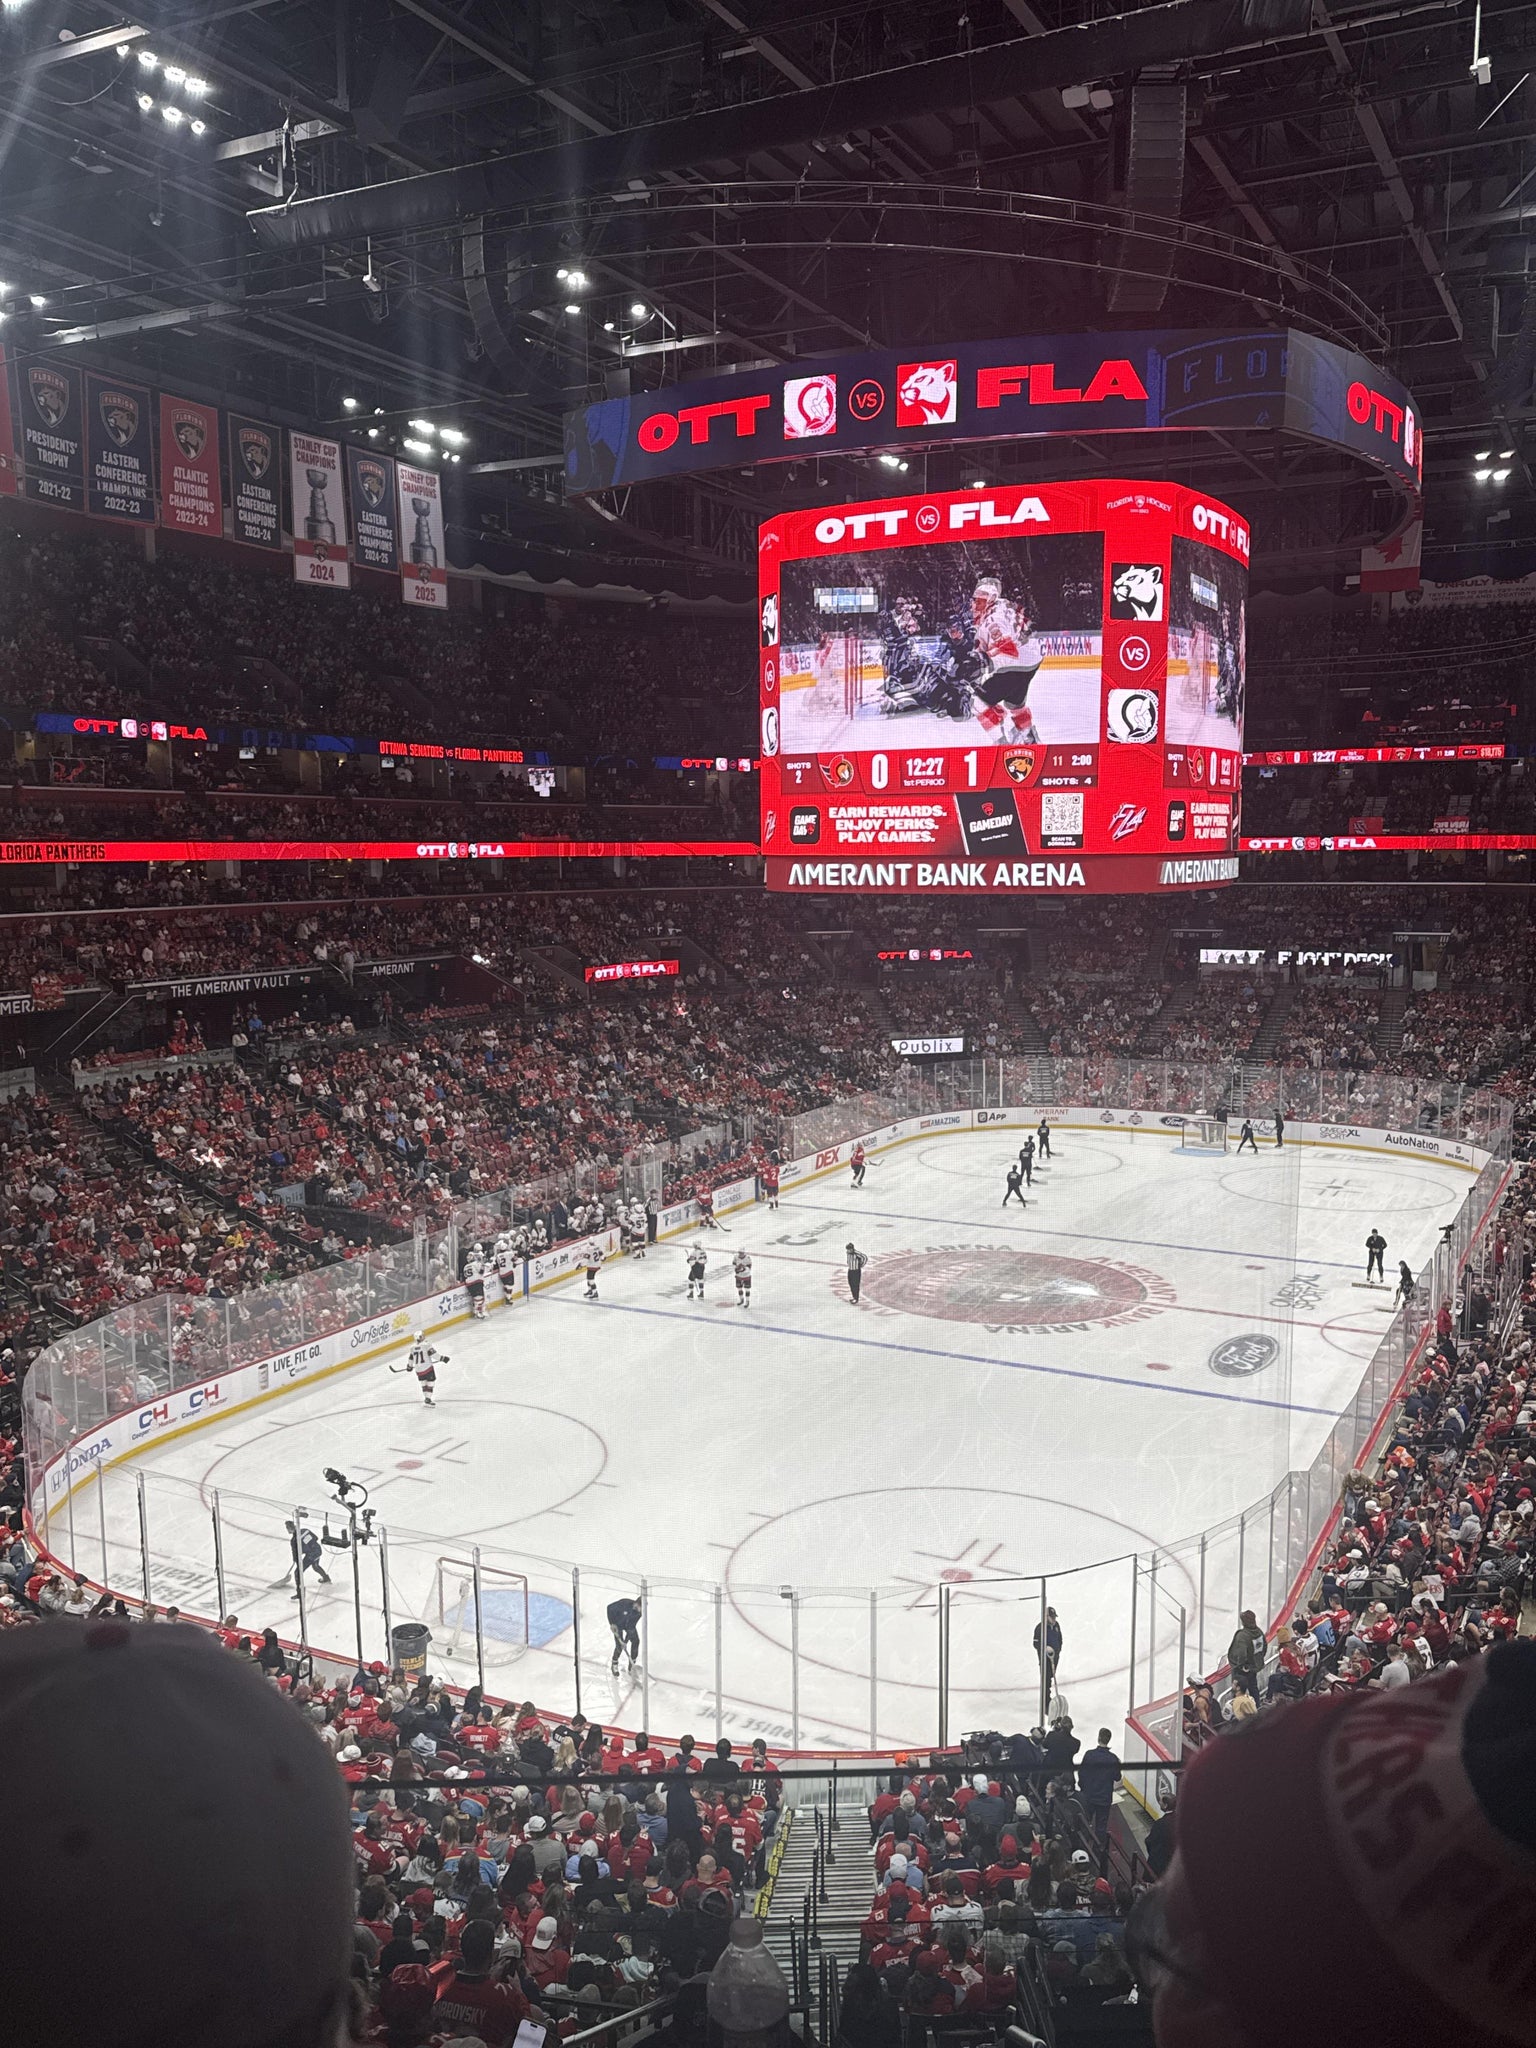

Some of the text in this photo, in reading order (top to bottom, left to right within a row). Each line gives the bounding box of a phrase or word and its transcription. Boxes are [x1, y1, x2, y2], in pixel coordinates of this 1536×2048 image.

[637, 359, 1149, 453] OTT VS FLA
[1347, 381, 1403, 443] OTT
[26, 428, 78, 454] PRESIDENTS'
[293, 436, 337, 458] STANLEY CUP
[37, 447, 69, 469] TROPHY
[102, 450, 140, 470] EASTERN
[296, 450, 336, 470] CHAMPIONS
[95, 463, 147, 486] CONFERENCE
[173, 466, 209, 485] ATLANTIC
[400, 468, 437, 487] STANLEY CUP
[38, 479, 72, 500] 2021-22
[174, 480, 209, 499] DIVISION
[242, 483, 271, 500] EASTERN
[402, 481, 437, 500] CHAMPIONS
[104, 496, 141, 514] 2022-23
[168, 493, 215, 514] CHAMPIONS
[236, 495, 277, 516] CONFERENCE
[175, 510, 209, 526] 2023-24
[238, 509, 276, 529] CHAMPIONS
[361, 510, 388, 526] EASTERN
[815, 496, 1051, 544] OTT VS FLA
[1192, 504, 1229, 540] OTT
[244, 524, 271, 541] 2023-24
[357, 522, 393, 540] CONFERENCE
[359, 535, 393, 553] CHAMPIONS
[364, 549, 389, 564] 2024-25
[309, 563, 335, 581] 2024
[415, 585, 436, 602] 2025
[1125, 647, 1144, 661] VS
[74, 718, 208, 740] OTT FLA
[379, 740, 524, 763] OTTAWA SENATORS VS FLORIDA PANTHERS
[1052, 754, 1093, 766] 11 2:00
[1294, 751, 1300, 763] 0
[1312, 750, 1337, 763] 12:27
[1376, 748, 1382, 760] 1
[681, 759, 714, 769] OTT
[786, 762, 811, 770] SHOTS
[872, 753, 888, 789] 0
[906, 757, 944, 777] 12:27
[964, 750, 977, 786] 1
[795, 770, 802, 784] 2
[915, 778, 945, 787] PERIOD
[1042, 777, 1092, 786] SHOTS: 4
[794, 814, 817, 825] GAME
[828, 804, 947, 818] EARN REWARDS.
[835, 817, 939, 831] ENJOY PERKS.
[969, 814, 1013, 833] GAMEDAY
[838, 830, 936, 843] PLAY GAMES.
[1249, 838, 1377, 849] OTT FLA
[0, 844, 105, 861] LORIDA PANTHERS
[416, 844, 446, 856] OTT
[480, 844, 504, 856] FLA
[788, 862, 1086, 887] AMERANT BANK ARENA
[1160, 858, 1221, 885] AMERANT
[877, 950, 973, 960] OTT FLA
[1277, 950, 1342, 967] FIGHT
[372, 962, 416, 977] AMERANT
[594, 964, 666, 979] OTT FLA
[170, 974, 291, 998] THE AMERANT VAULT
[900, 1039, 952, 1054] Publix
[930, 1116, 960, 1127] AMAZING
[1165, 1116, 1184, 1127] Ford
[1384, 1133, 1439, 1151] AutoNation
[815, 1147, 841, 1170] DEX
[350, 1319, 391, 1349] Surfside
[273, 1359, 293, 1373] LIVE.
[294, 1350, 307, 1366] FIT.
[309, 1344, 322, 1359] GO.
[413, 1351, 425, 1365] 71
[1219, 1340, 1271, 1371] Ford
[181, 1407, 202, 1419] Cooper
[131, 1428, 151, 1441] Cooper
[61, 1437, 113, 1482] HONDA
[434, 2000, 488, 2023] BROVSKY
